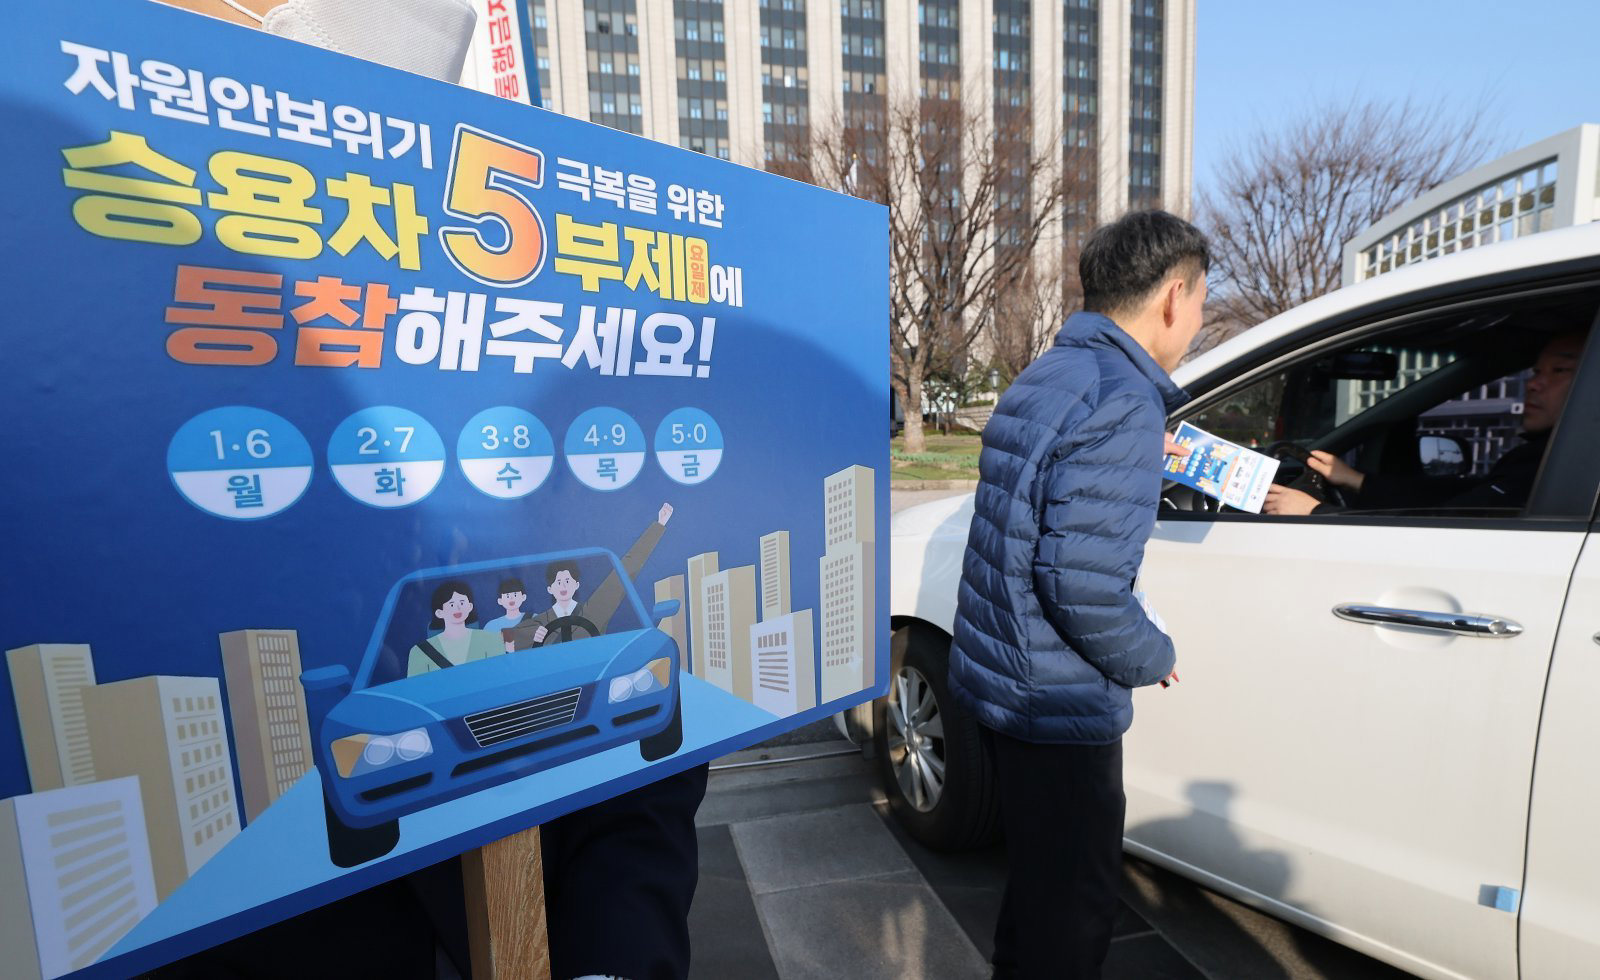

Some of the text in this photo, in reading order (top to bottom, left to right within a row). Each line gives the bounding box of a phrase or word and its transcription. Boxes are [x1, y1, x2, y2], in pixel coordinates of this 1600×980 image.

[60, 40, 725, 229] 자원안보위기 극복을 위한
[62, 130, 430, 272] 승용차
[690, 245, 706, 299] 요일제
[164, 264, 717, 379] 동참해주세요!
[374, 466, 406, 498] 화
[495, 462, 523, 489] 수
[597, 458, 619, 482] 목
[681, 455, 701, 478] 금
[227, 473, 265, 509] 월
